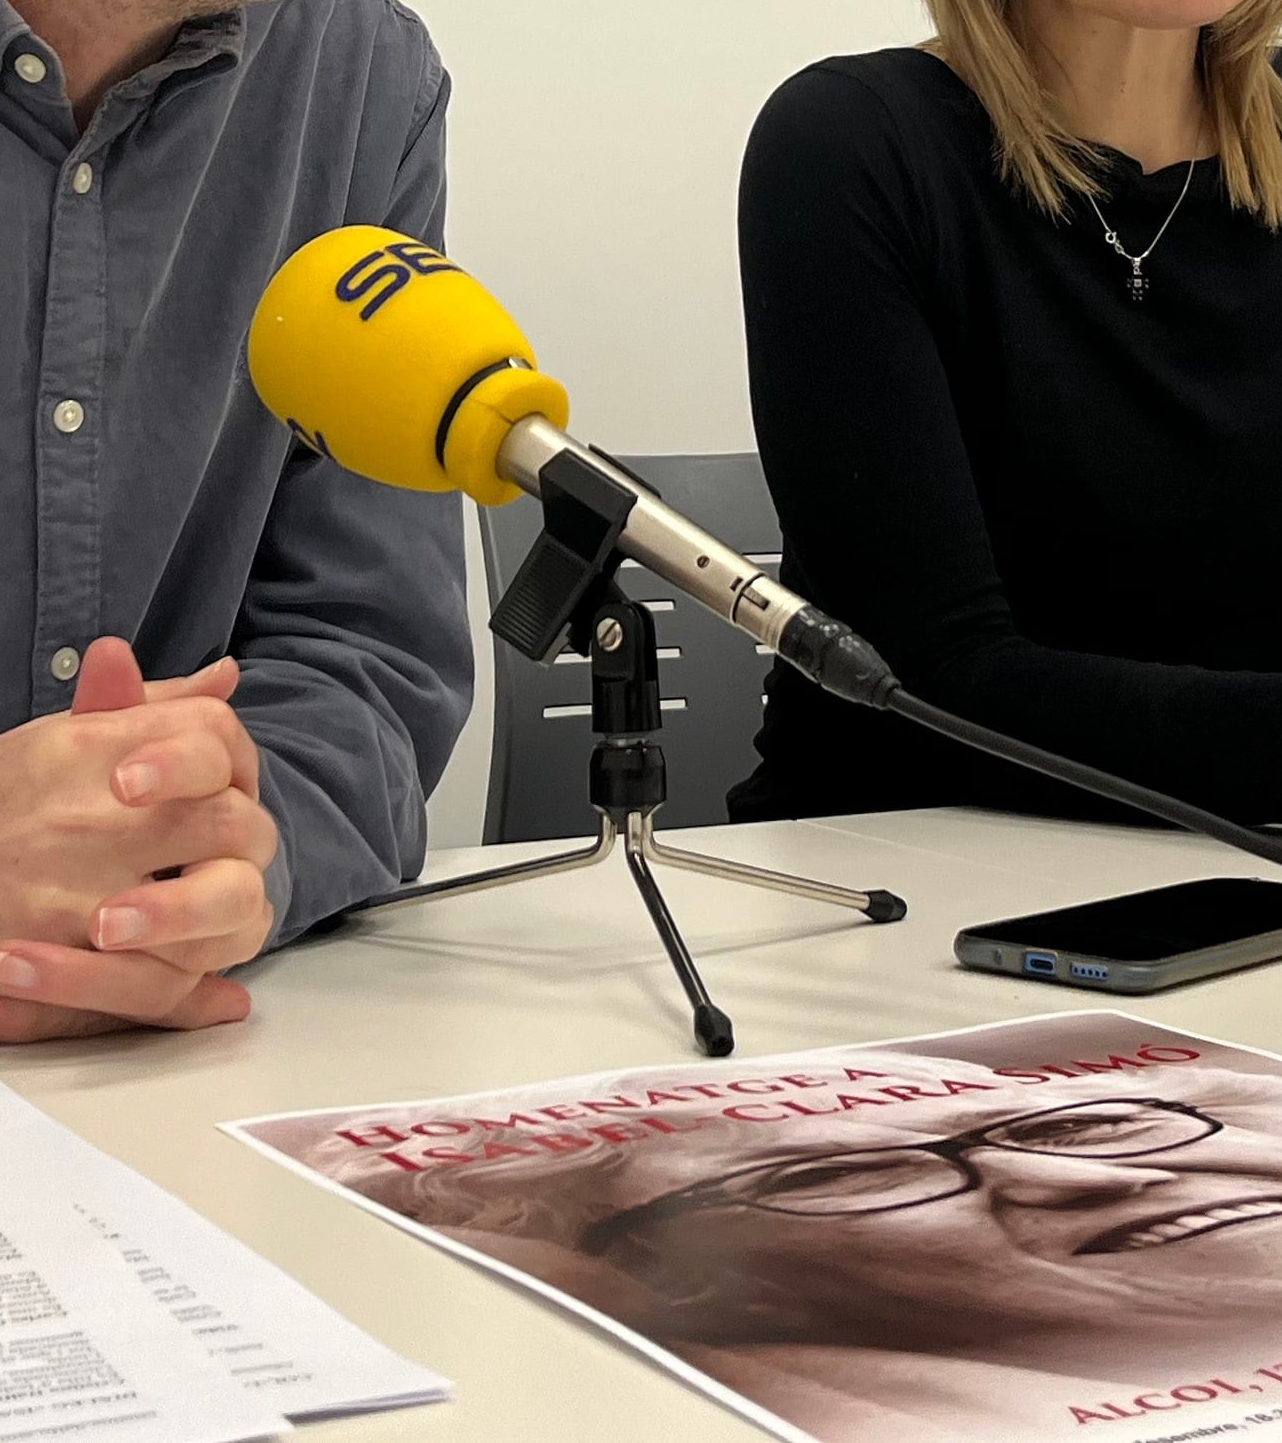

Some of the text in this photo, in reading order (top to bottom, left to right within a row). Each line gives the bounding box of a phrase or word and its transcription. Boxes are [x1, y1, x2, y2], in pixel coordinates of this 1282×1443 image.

[336, 1066, 889, 1148] HOMENATGE A
[381, 1043, 1201, 1173] ISABEL-CLARA SIMÓ
[1067, 1378, 1264, 1427] ALCOI,
